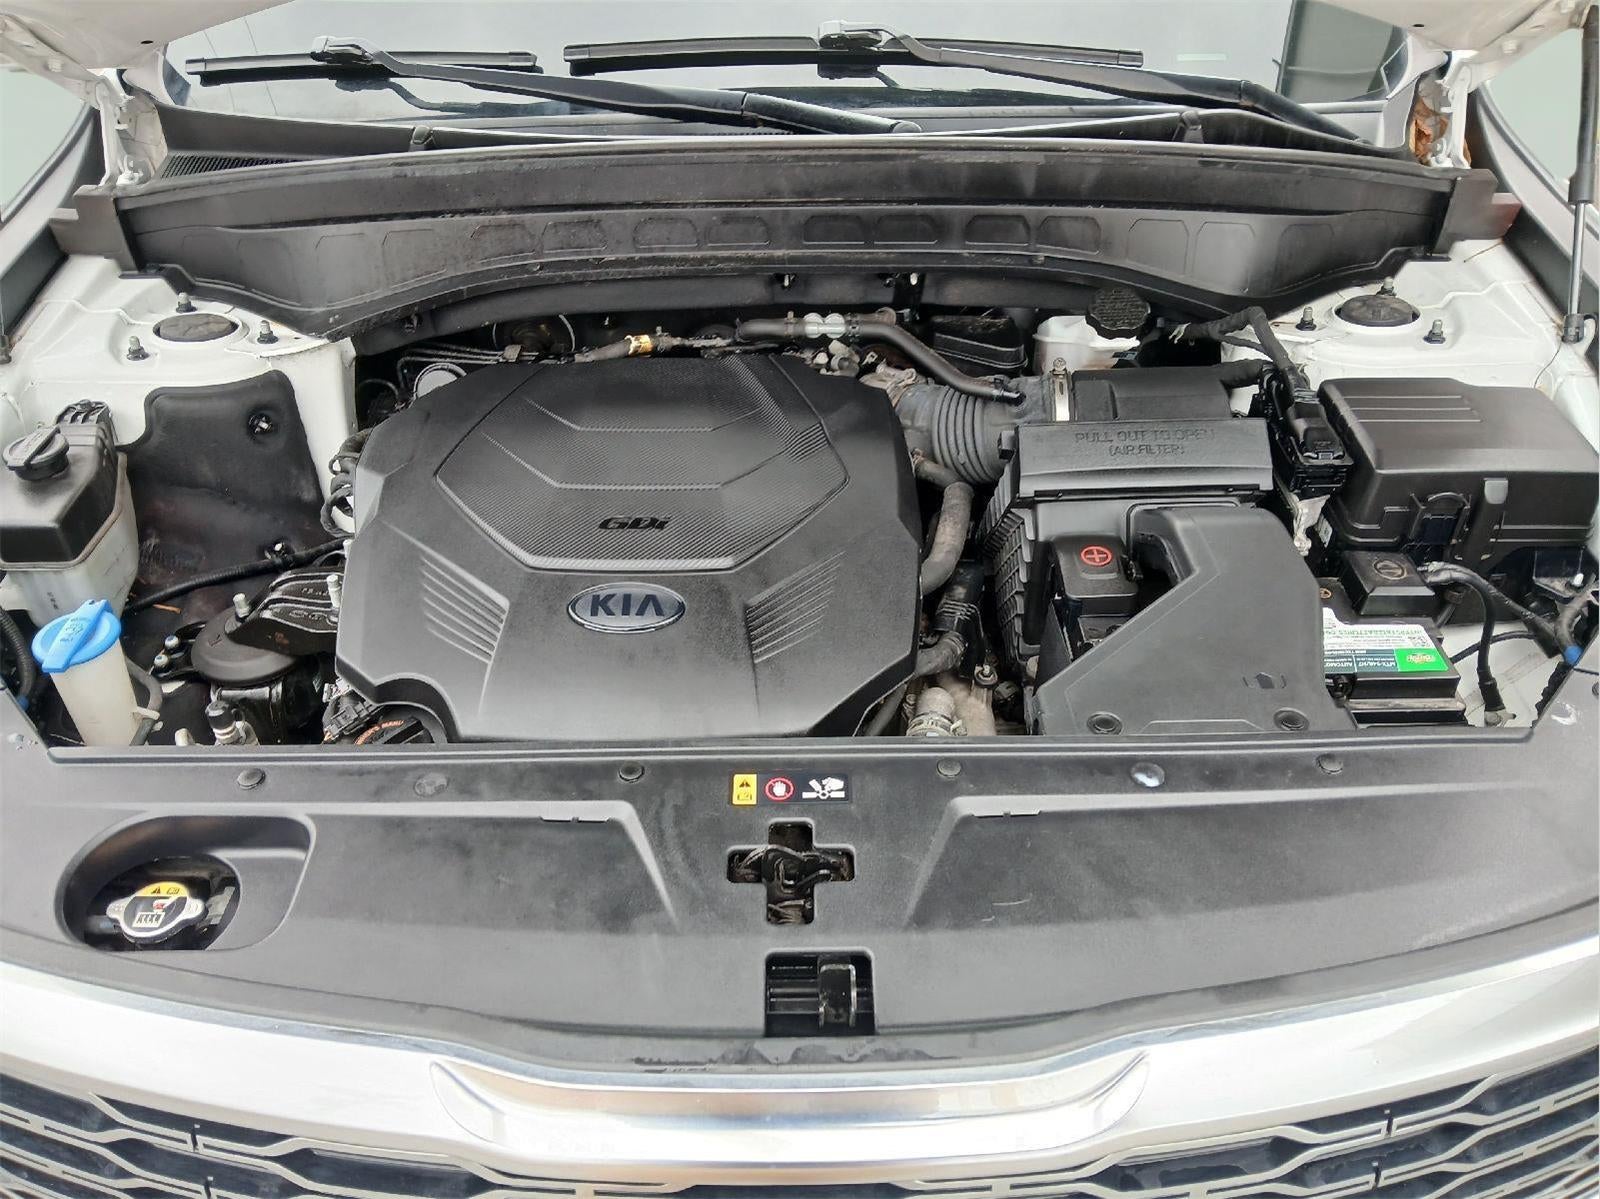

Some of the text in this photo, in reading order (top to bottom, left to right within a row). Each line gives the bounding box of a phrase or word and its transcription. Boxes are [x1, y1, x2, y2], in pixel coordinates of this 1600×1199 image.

[1074, 428, 1214, 443] PULL OUT TO OPEN
[590, 593, 665, 617] KIA
